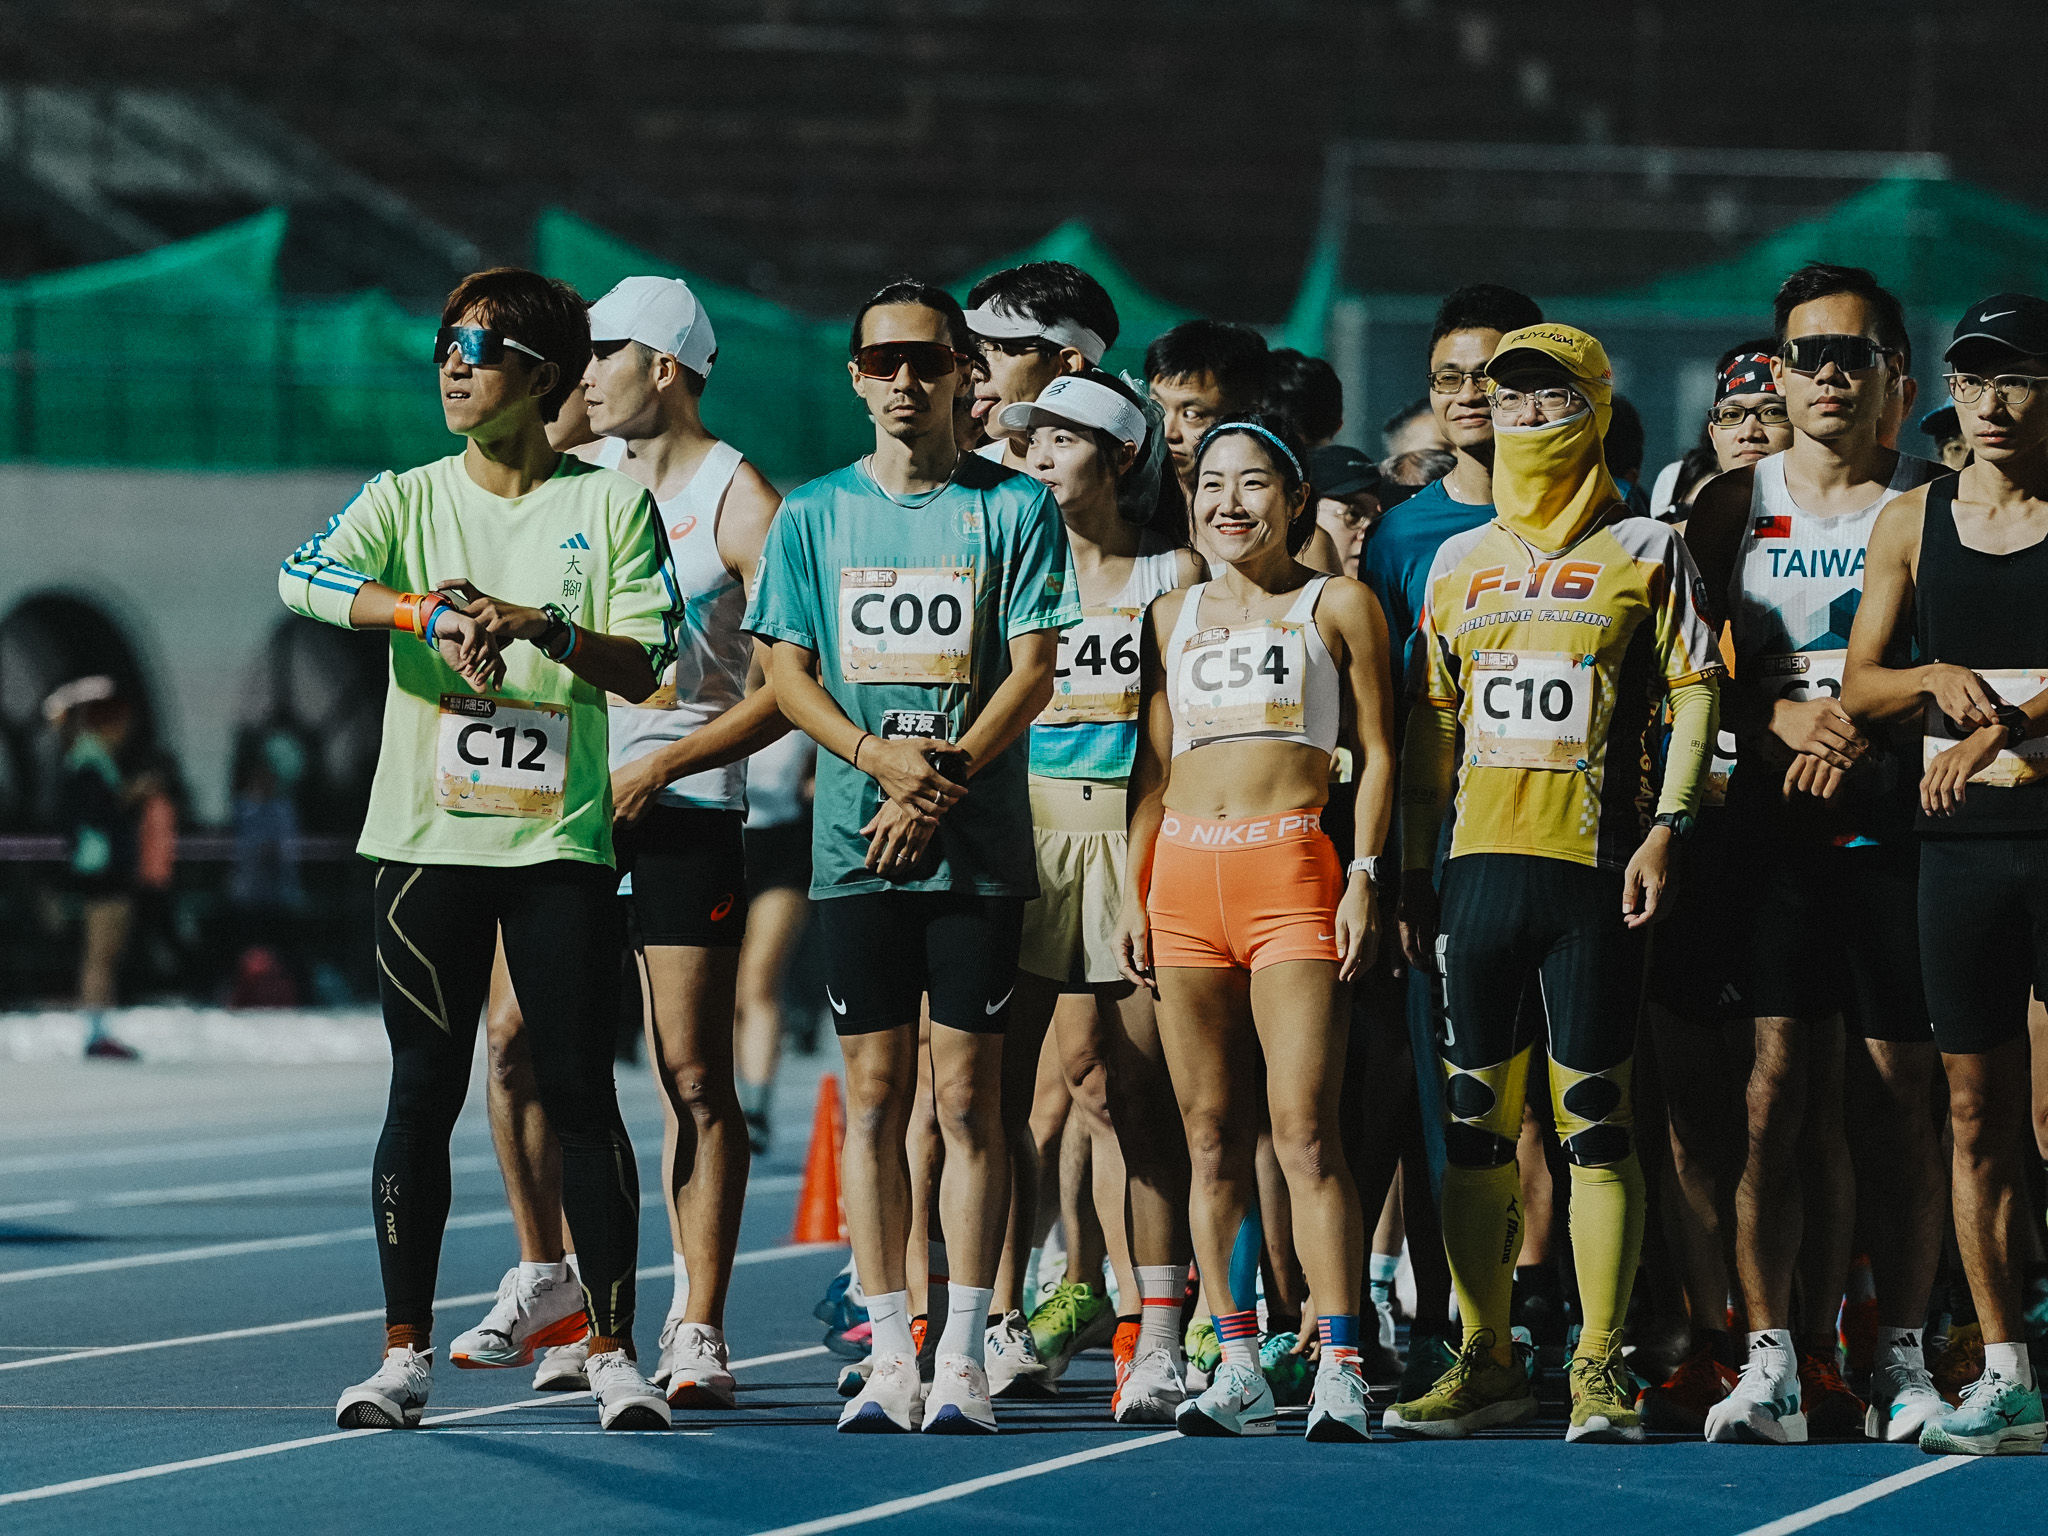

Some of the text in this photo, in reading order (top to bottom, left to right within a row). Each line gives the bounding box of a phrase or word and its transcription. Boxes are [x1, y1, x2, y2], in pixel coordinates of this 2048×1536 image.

[1767, 548, 1867, 577] TAIWA
[1465, 560, 1605, 612] F-16
[851, 593, 962, 636] C00
[1454, 609, 1612, 638] FIGHTING FALCON
[1191, 645, 1289, 692] C54
[1483, 676, 1573, 722] C10
[897, 713, 935, 733] 好友
[457, 722, 548, 772] C12
[1190, 821, 1270, 845] NIKE
[386, 1211, 398, 1244] 2XU
